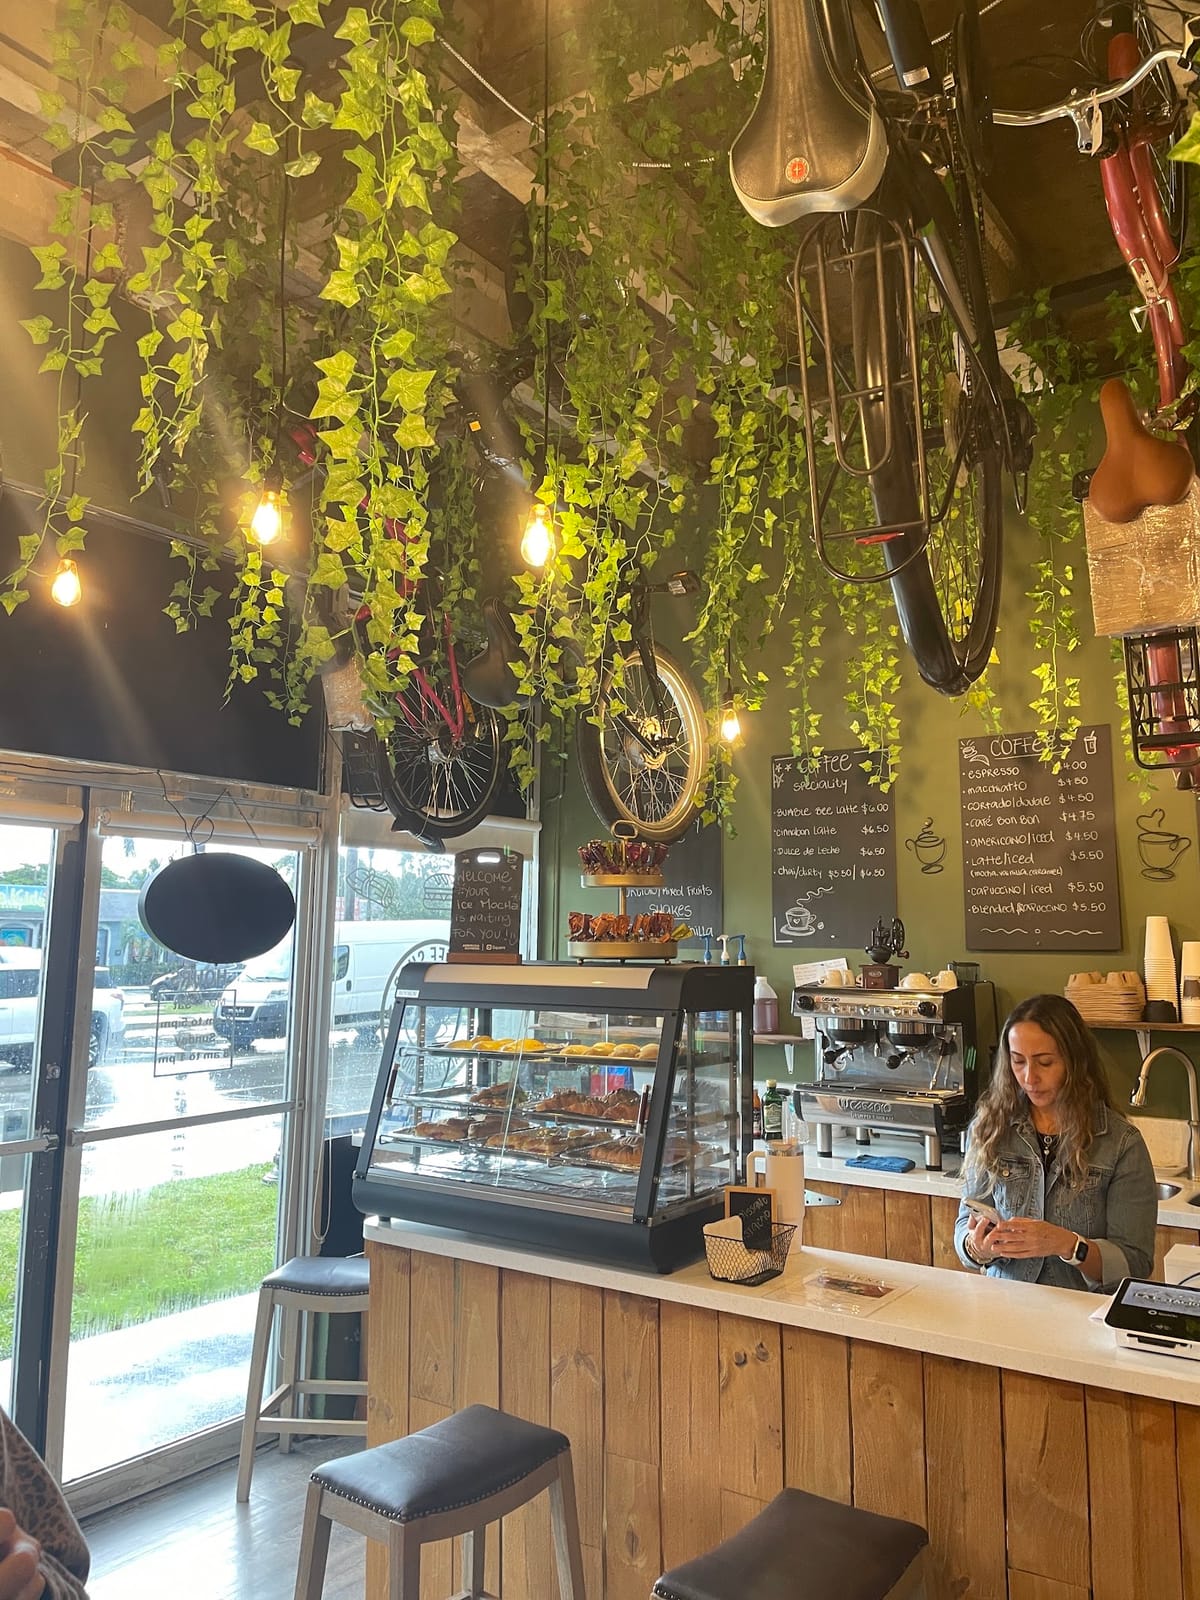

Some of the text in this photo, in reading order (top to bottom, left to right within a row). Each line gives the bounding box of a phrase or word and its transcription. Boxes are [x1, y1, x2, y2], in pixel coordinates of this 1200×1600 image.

[1063, 760, 1088, 770] 4.00
[1058, 792, 1095, 804] $4.50
[860, 802, 889, 815] $6.00
[1059, 810, 1096, 822] $4.75
[860, 824, 890, 835] $6.50
[1064, 830, 1099, 841] $4.50
[859, 846, 886, 856] $6.50
[1069, 850, 1105, 861] $5.50
[1067, 881, 1105, 894] $5.50
[1072, 901, 1107, 912] $5.50
